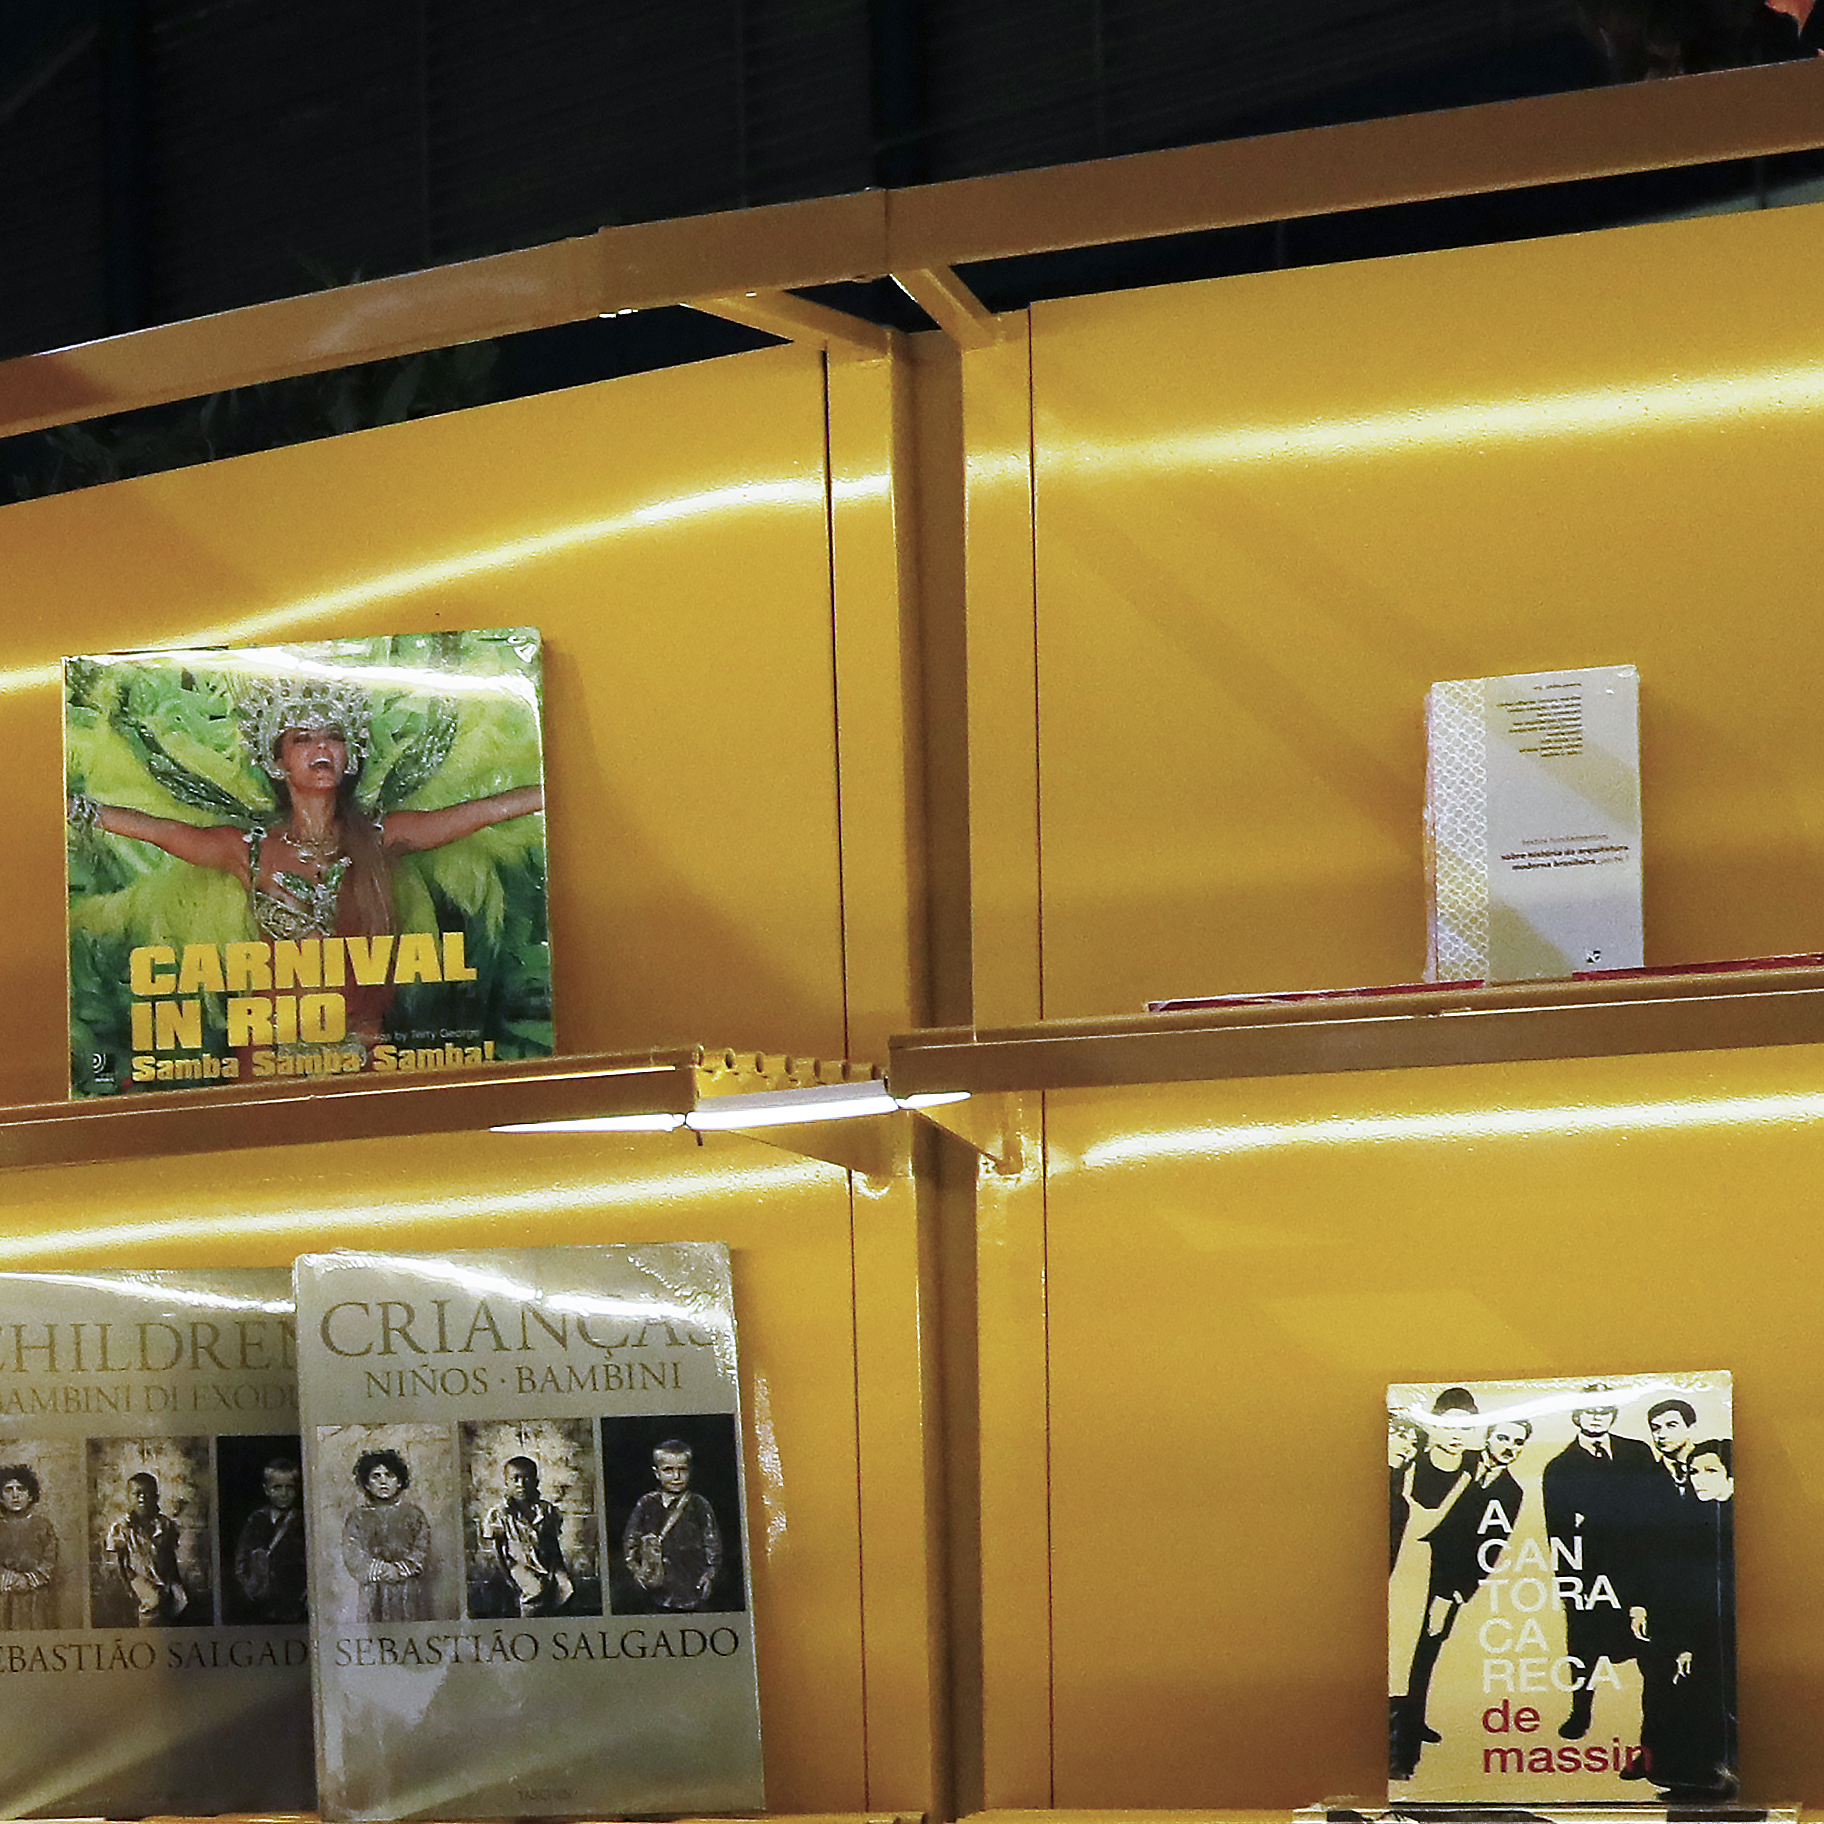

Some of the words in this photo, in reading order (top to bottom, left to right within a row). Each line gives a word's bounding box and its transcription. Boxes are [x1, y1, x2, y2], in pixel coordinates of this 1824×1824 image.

[129, 932, 476, 995] CARNIVAL
[130, 1000, 202, 1050] IN
[225, 993, 346, 1046] RIO
[132, 1052, 239, 1082] Samba
[252, 1049, 360, 1077] Samba
[373, 1040, 495, 1071] Samba!
[145, 1384, 179, 1411] DI
[366, 1363, 488, 1399] NIÑOS
[517, 1361, 682, 1396] BAMBINI
[1477, 1500, 1512, 1535] A
[1477, 1536, 1583, 1572] CAN
[1478, 1574, 1622, 1613] TORA
[335, 1629, 539, 1667] SEBASTIÃO
[552, 1627, 739, 1661] SALGADO
[1479, 1616, 1549, 1654] CA
[1483, 1656, 1622, 1694] RECA
[1482, 1698, 1540, 1734] de
[1483, 1736, 1651, 1774] massin
